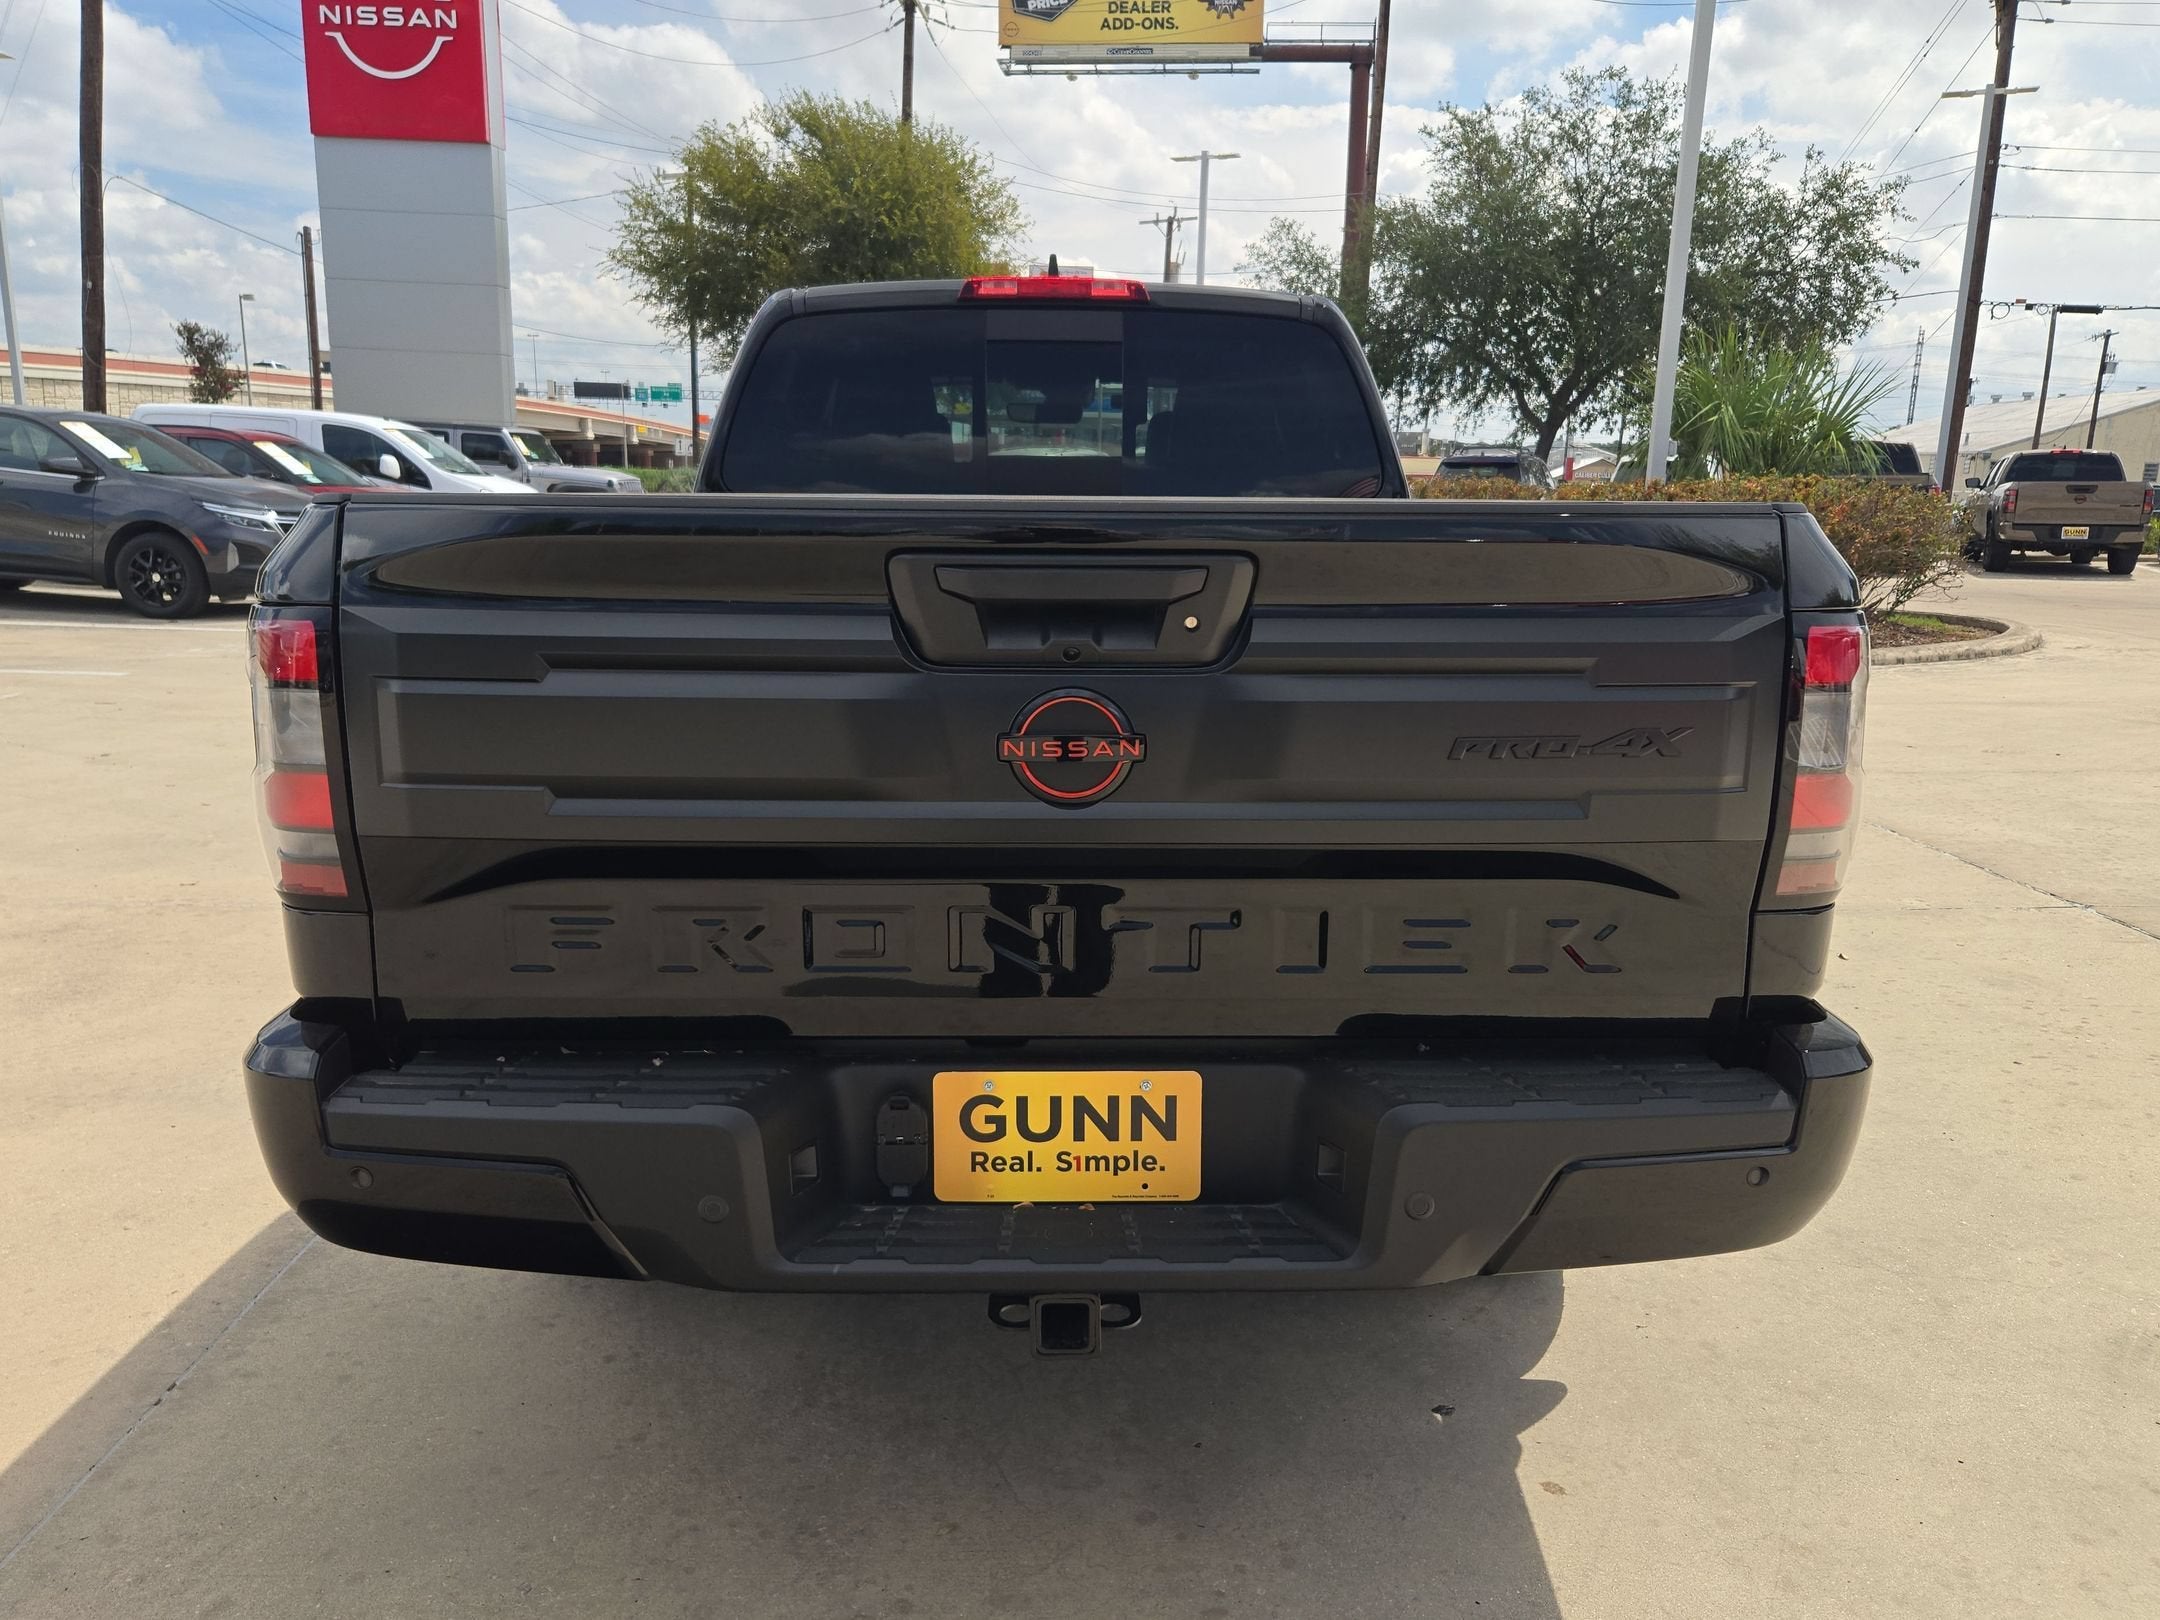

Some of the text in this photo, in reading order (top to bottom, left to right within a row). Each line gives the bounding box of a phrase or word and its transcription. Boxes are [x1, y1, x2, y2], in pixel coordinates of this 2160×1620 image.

[319, 4, 457, 29] NISSAN
[1108, 1, 1171, 14] DEALER
[1100, 17, 1179, 31] ADD-ONS.
[1003, 739, 1141, 758] NISSAN
[1446, 727, 1696, 761] PRO-4X
[507, 904, 1624, 974] FRONTIER
[959, 1094, 1178, 1143] GUNN
[970, 1150, 1166, 1177] Real. S1mple.
